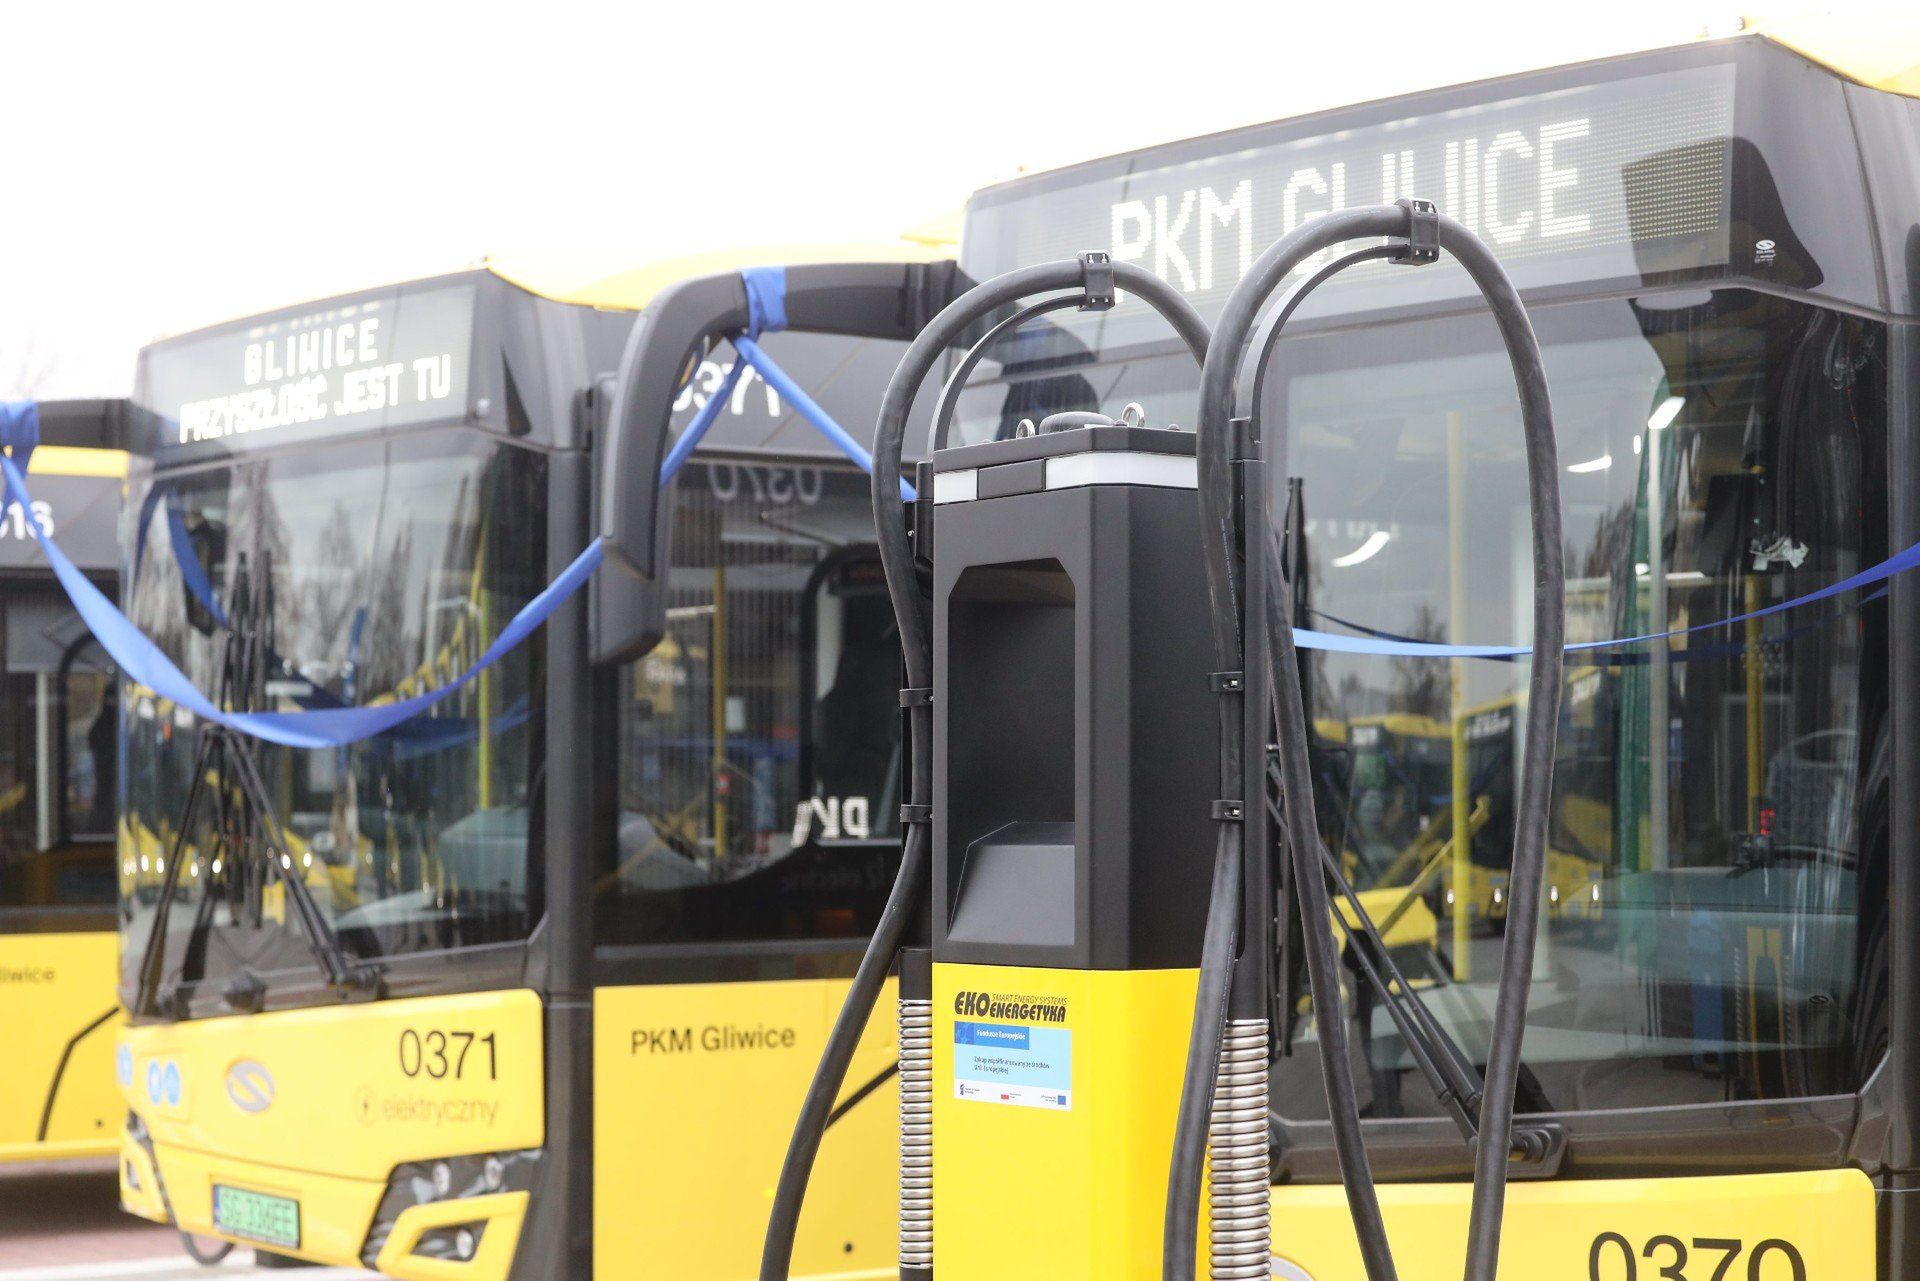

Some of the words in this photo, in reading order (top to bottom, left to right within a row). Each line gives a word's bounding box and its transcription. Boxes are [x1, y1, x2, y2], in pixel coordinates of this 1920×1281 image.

[1111, 179, 1252, 302] PKM
[244, 317, 380, 385] GLIWICE
[333, 362, 404, 416] JEST
[413, 353, 451, 401] TU
[954, 991, 990, 1017] EKO
[990, 1001, 1067, 1022] ENERGETYKA
[992, 993, 1013, 1003] SMART
[1014, 995, 1038, 1004] ENERGY
[1040, 997, 1067, 1006] SYSTEMS
[399, 1029, 497, 1080] 0371
[631, 1028, 693, 1055] PKM
[700, 1024, 796, 1052] Gliwice
